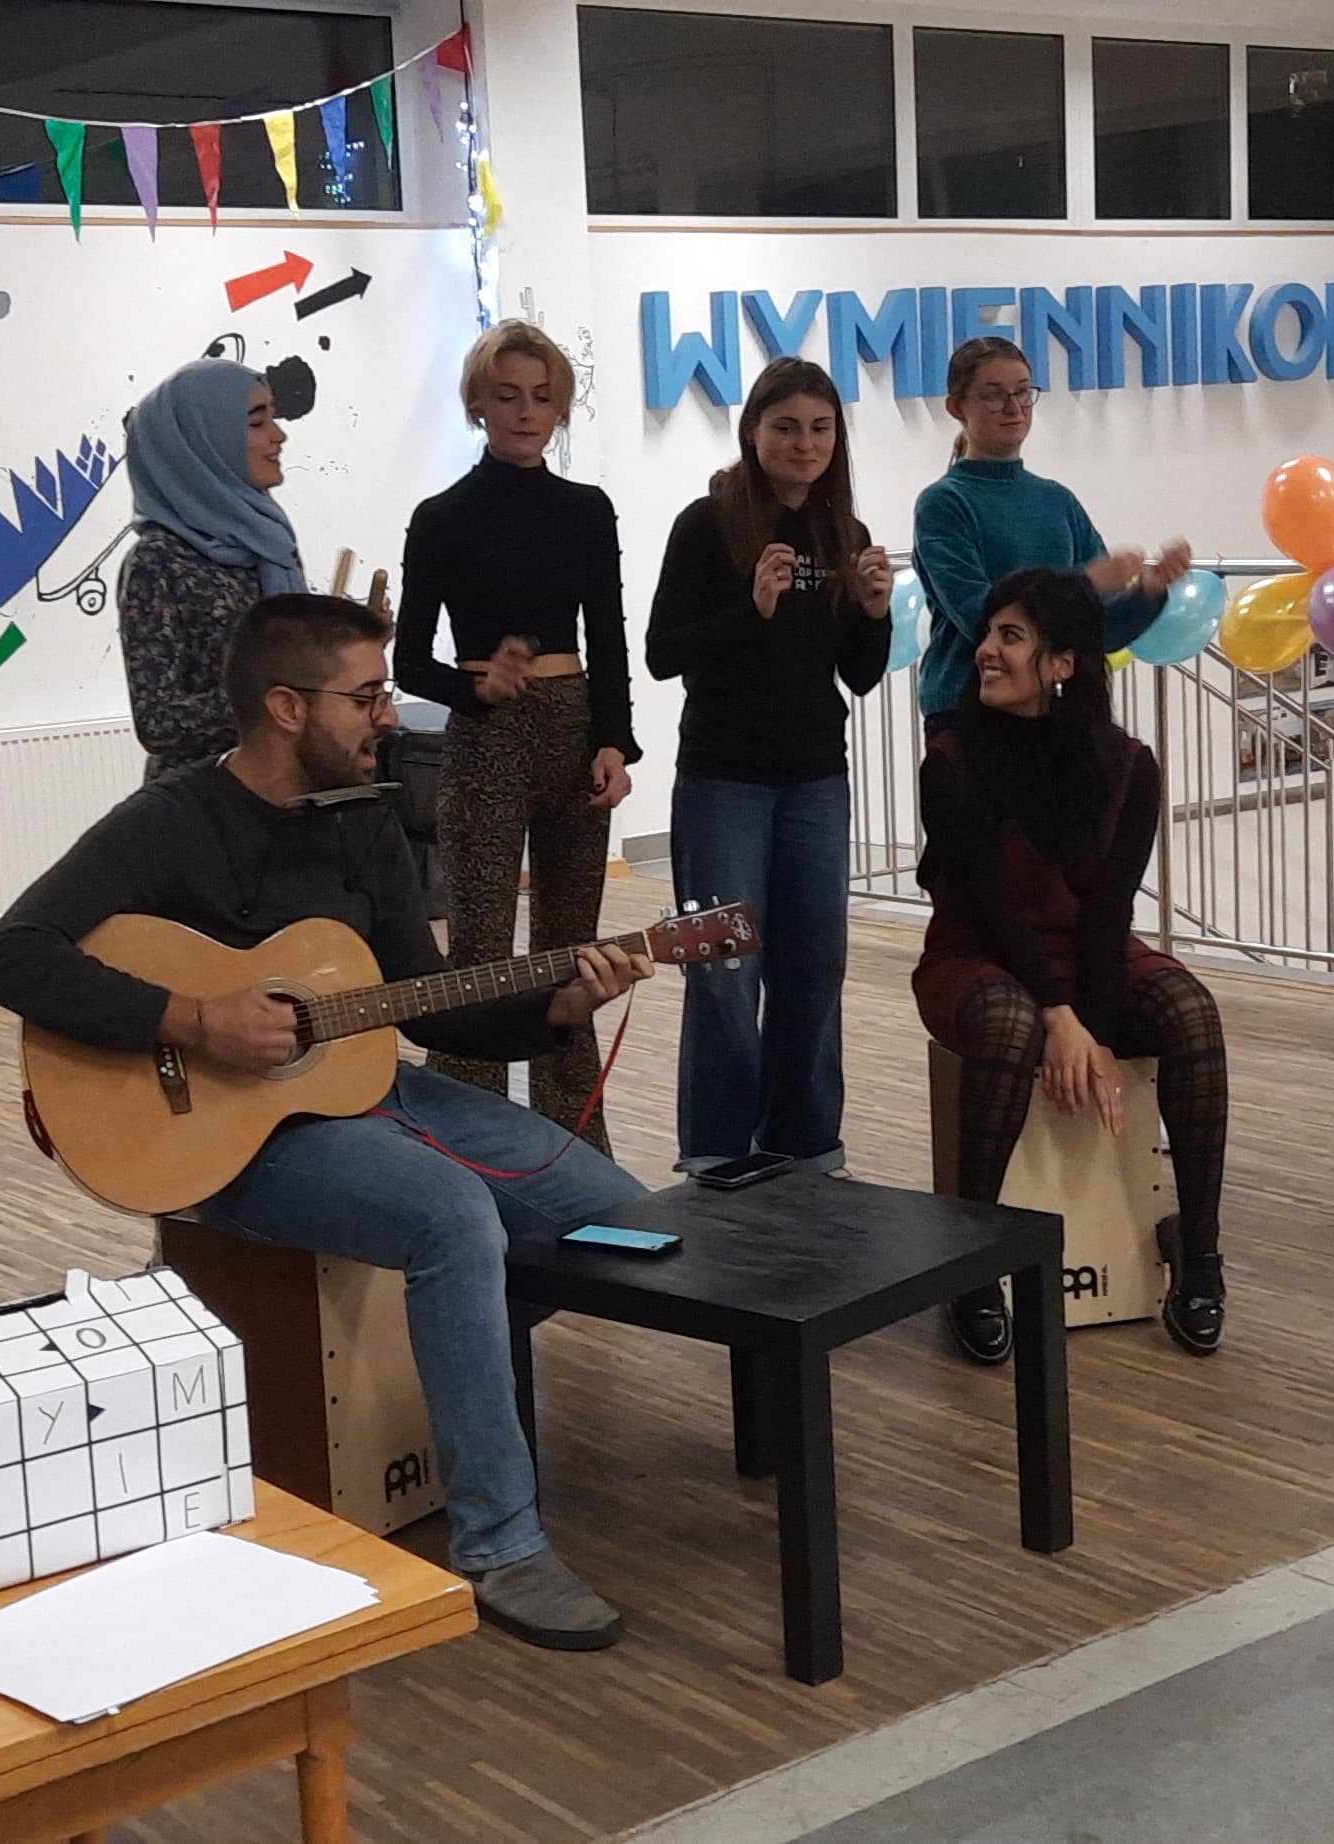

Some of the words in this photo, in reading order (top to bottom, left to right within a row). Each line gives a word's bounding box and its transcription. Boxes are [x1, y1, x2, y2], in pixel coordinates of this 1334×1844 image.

[75, 1327, 107, 1350] O
[171, 1363, 208, 1411] M
[184, 1491, 202, 1531] E
